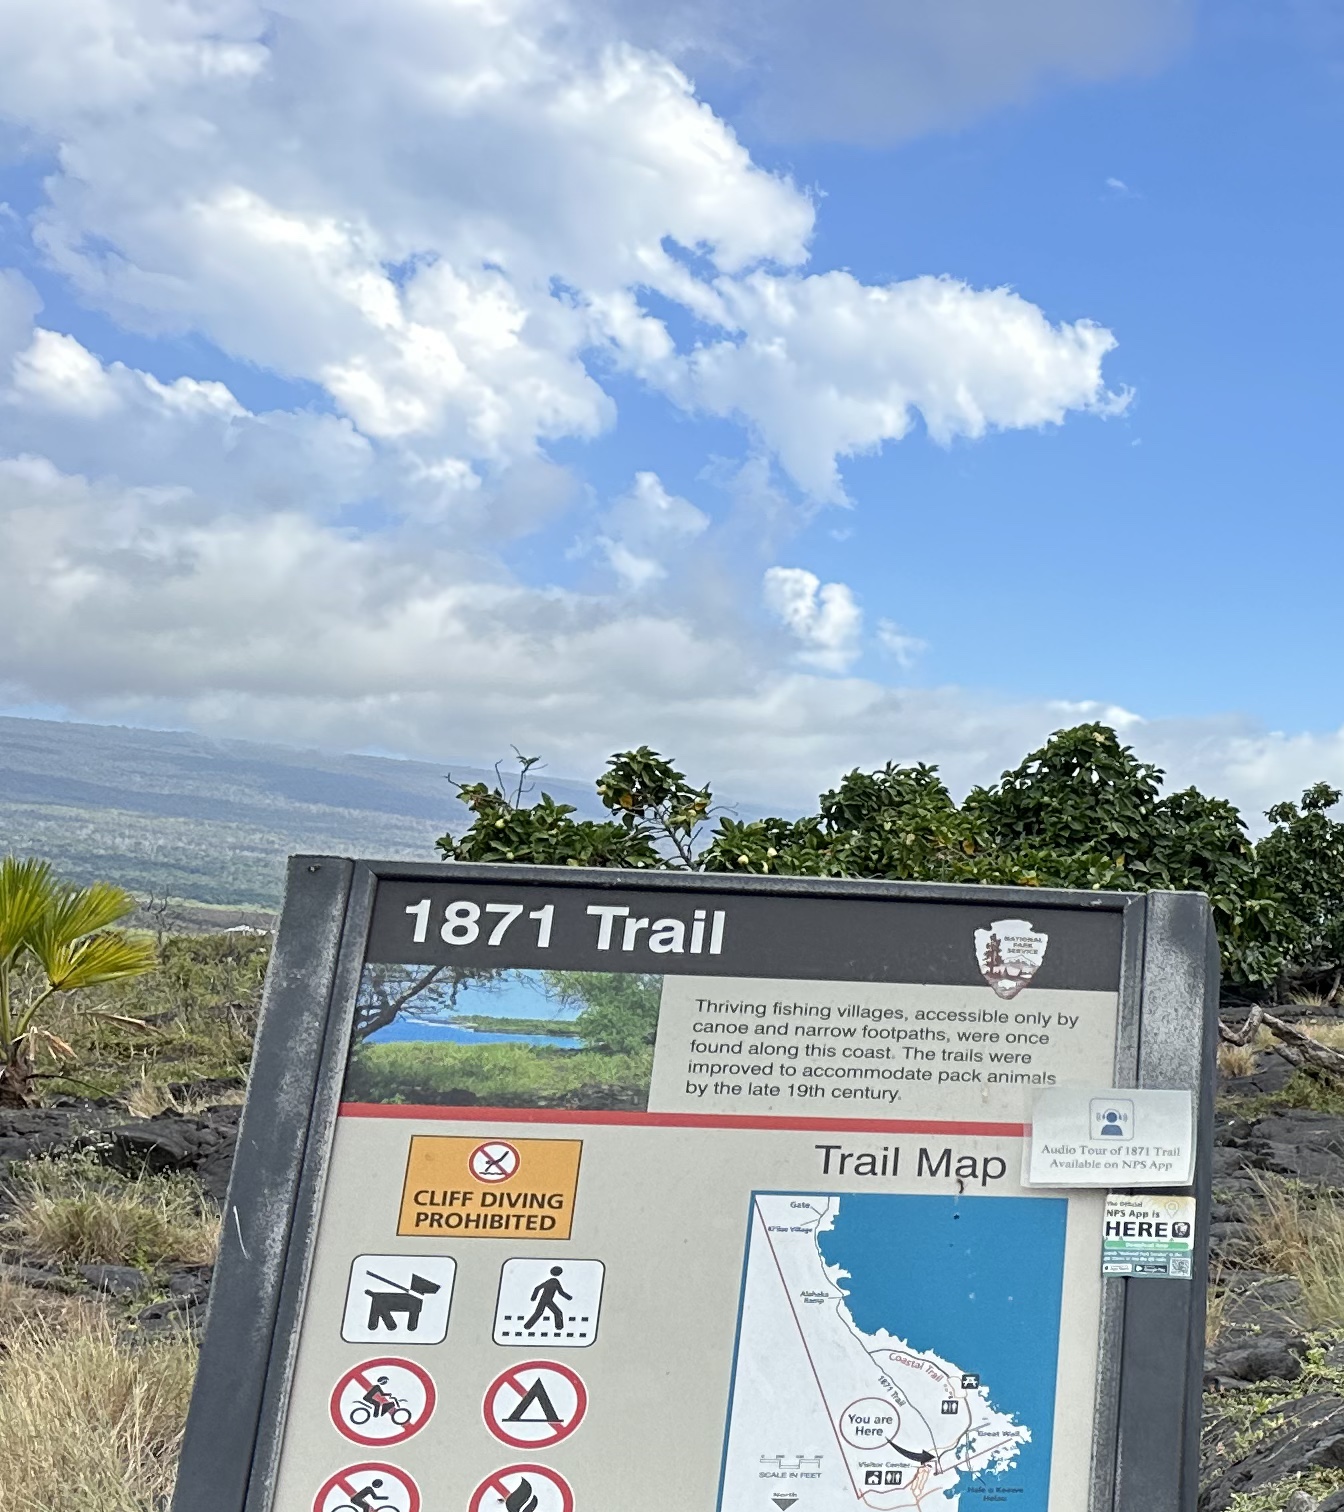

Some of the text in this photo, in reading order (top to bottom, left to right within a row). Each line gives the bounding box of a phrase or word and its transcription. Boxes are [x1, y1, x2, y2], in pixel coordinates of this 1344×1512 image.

[404, 899, 727, 955] 1871 Trail
[695, 999, 1080, 1029] Thriving fishing villages, accessible only by
[692, 1022, 1050, 1045] canoe and narrow footpaths, were once
[690, 1039, 1032, 1064] found along this coast. The trails were
[687, 1059, 1057, 1085] improved to accommodate pack animals
[685, 1080, 902, 1103] by the late 19th century.
[814, 1144, 1007, 1180] Trail Map
[1041, 1144, 1180, 1157] Audio Tour of 1871 Trail
[1050, 1158, 1173, 1171] Available on NPS App
[413, 1189, 564, 1210] CLIFF DIVING
[414, 1212, 557, 1232] PROHIBITED
[1106, 1209, 1160, 1219] NPS App is
[1105, 1221, 1168, 1237] HERE
[889, 1353, 944, 1382] Coastal Trail
[878, 1375, 906, 1407] 1871 Trail
[848, 1414, 893, 1425] You are
[855, 1426, 883, 1436] Here
